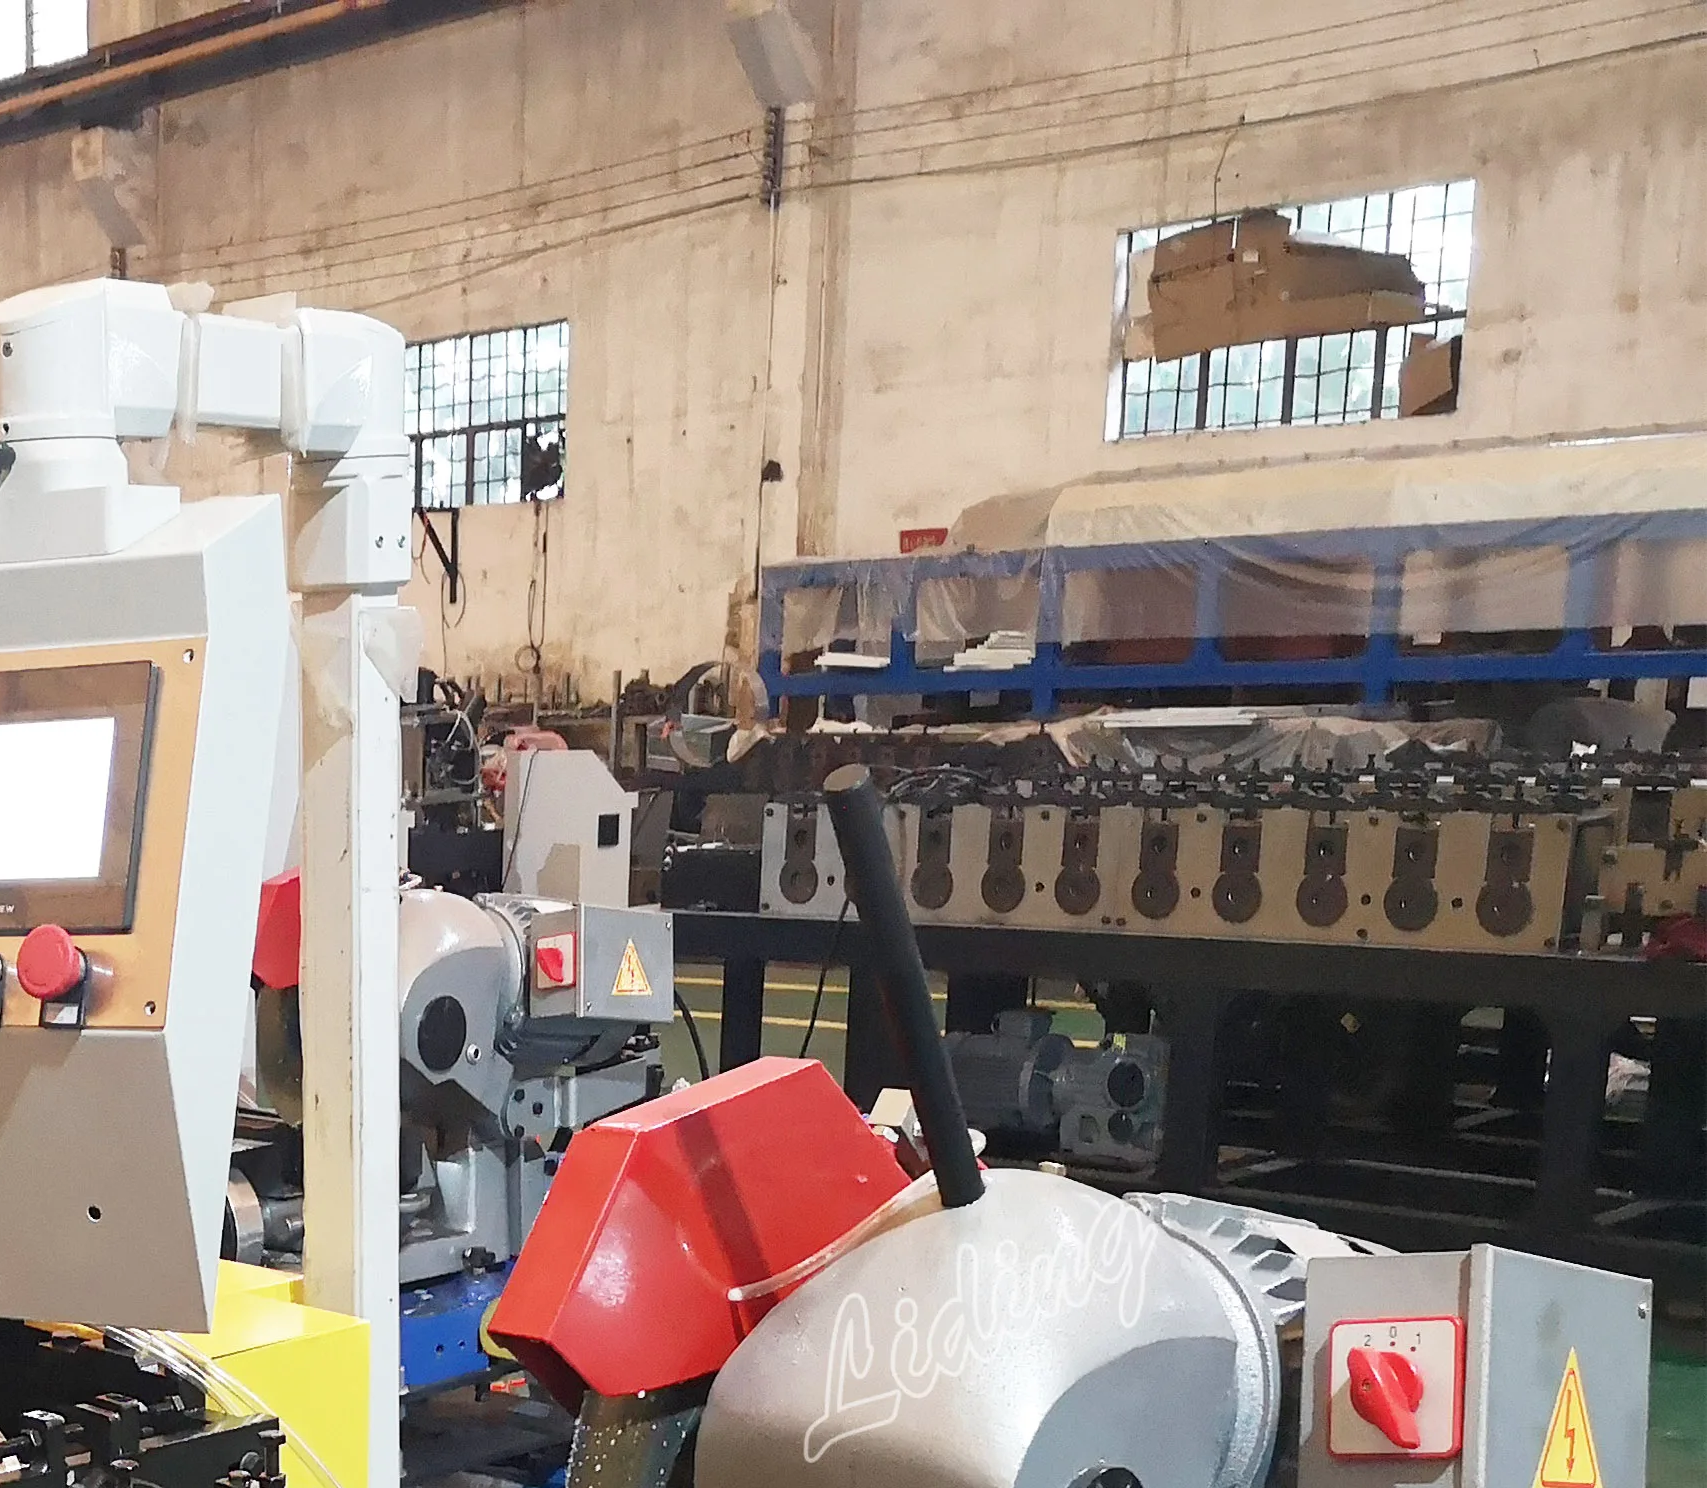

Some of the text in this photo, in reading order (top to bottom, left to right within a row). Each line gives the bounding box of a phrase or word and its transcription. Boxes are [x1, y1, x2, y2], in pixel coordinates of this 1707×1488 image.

[1363, 1325, 1422, 1347] 2 0 1
